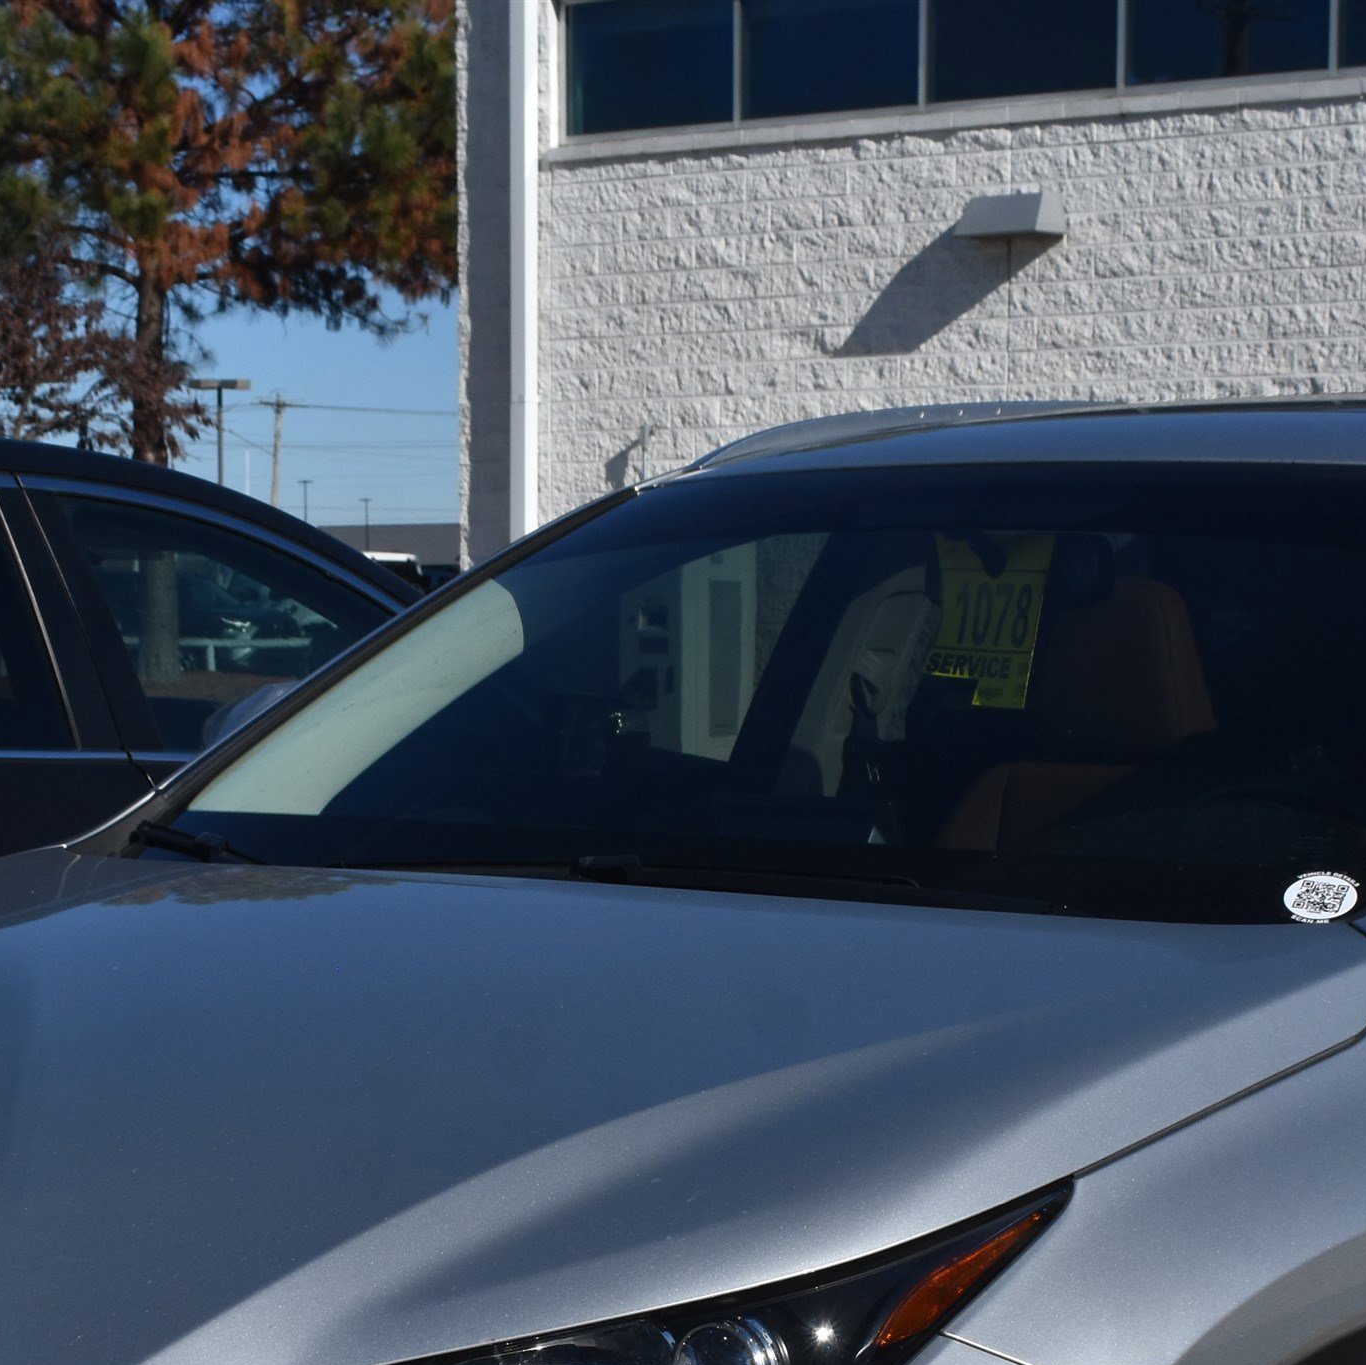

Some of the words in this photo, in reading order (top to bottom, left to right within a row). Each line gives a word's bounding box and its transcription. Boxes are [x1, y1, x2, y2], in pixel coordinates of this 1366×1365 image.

[955, 582, 1033, 649] 1078
[924, 652, 1012, 679] SERVICE
[1296, 871, 1332, 879] VEHICLE
[1333, 872, 1360, 887] DETAILS
[1290, 914, 1314, 924] SCAN
